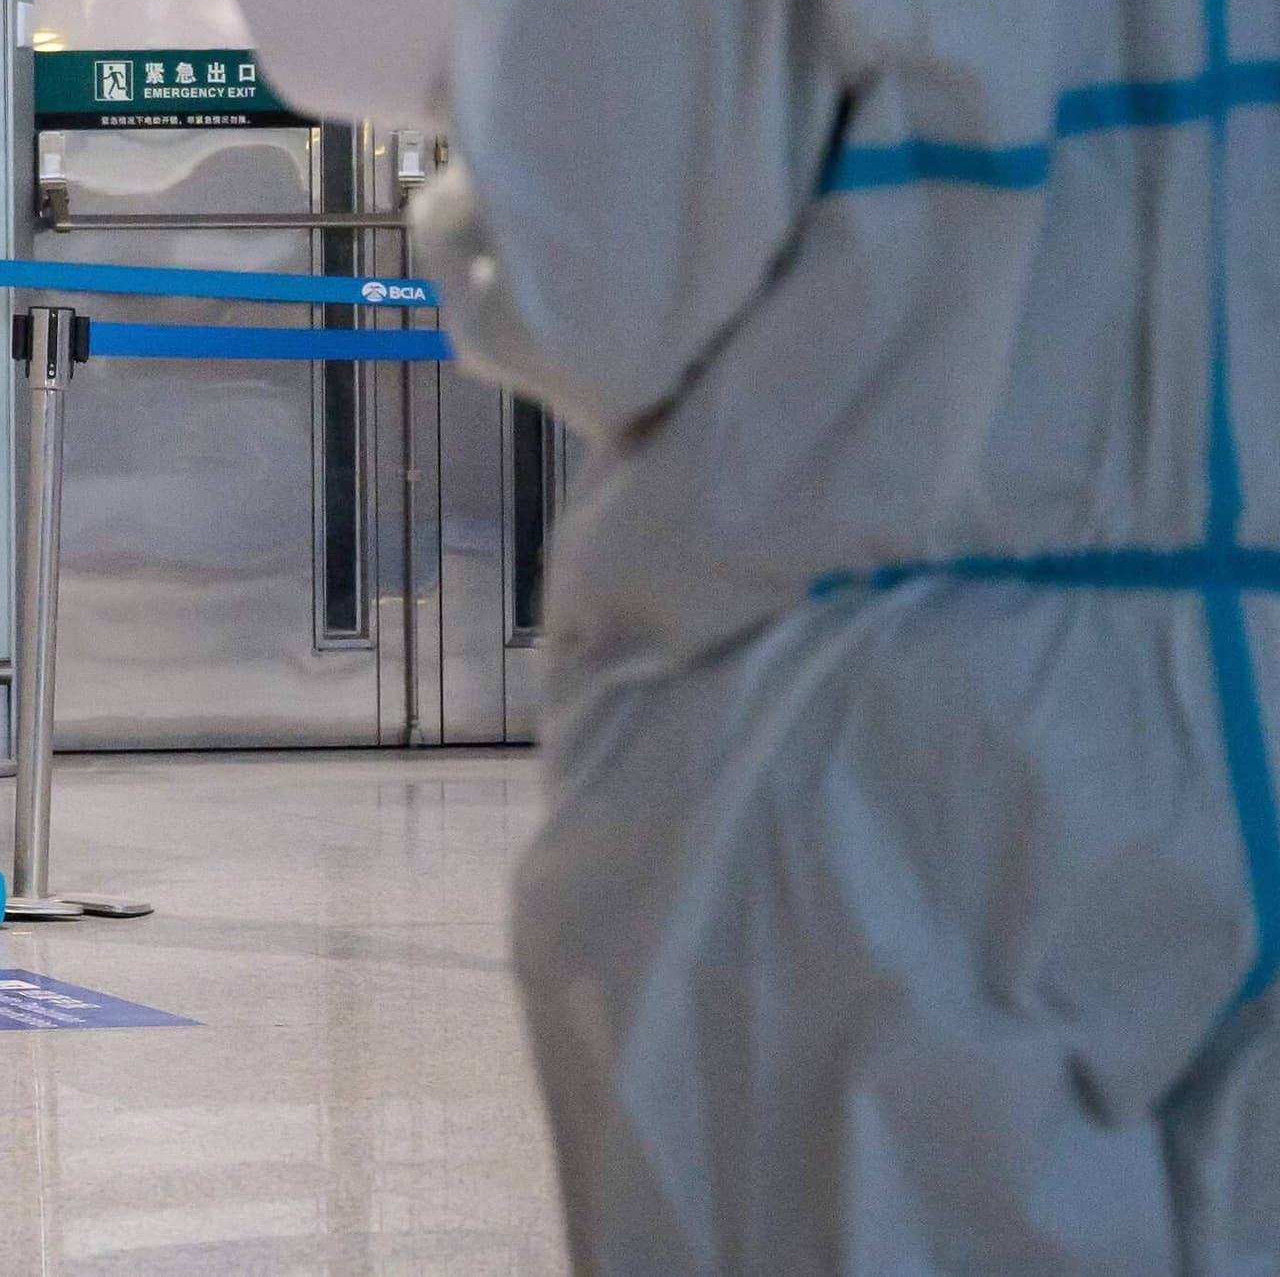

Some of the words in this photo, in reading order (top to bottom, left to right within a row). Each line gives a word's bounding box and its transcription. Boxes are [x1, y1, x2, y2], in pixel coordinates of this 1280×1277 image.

[145, 62, 256, 84] 紧急出口
[144, 87, 225, 99] EMERGENCY
[228, 87, 256, 98] EXIT
[389, 286, 426, 300] BCIA
